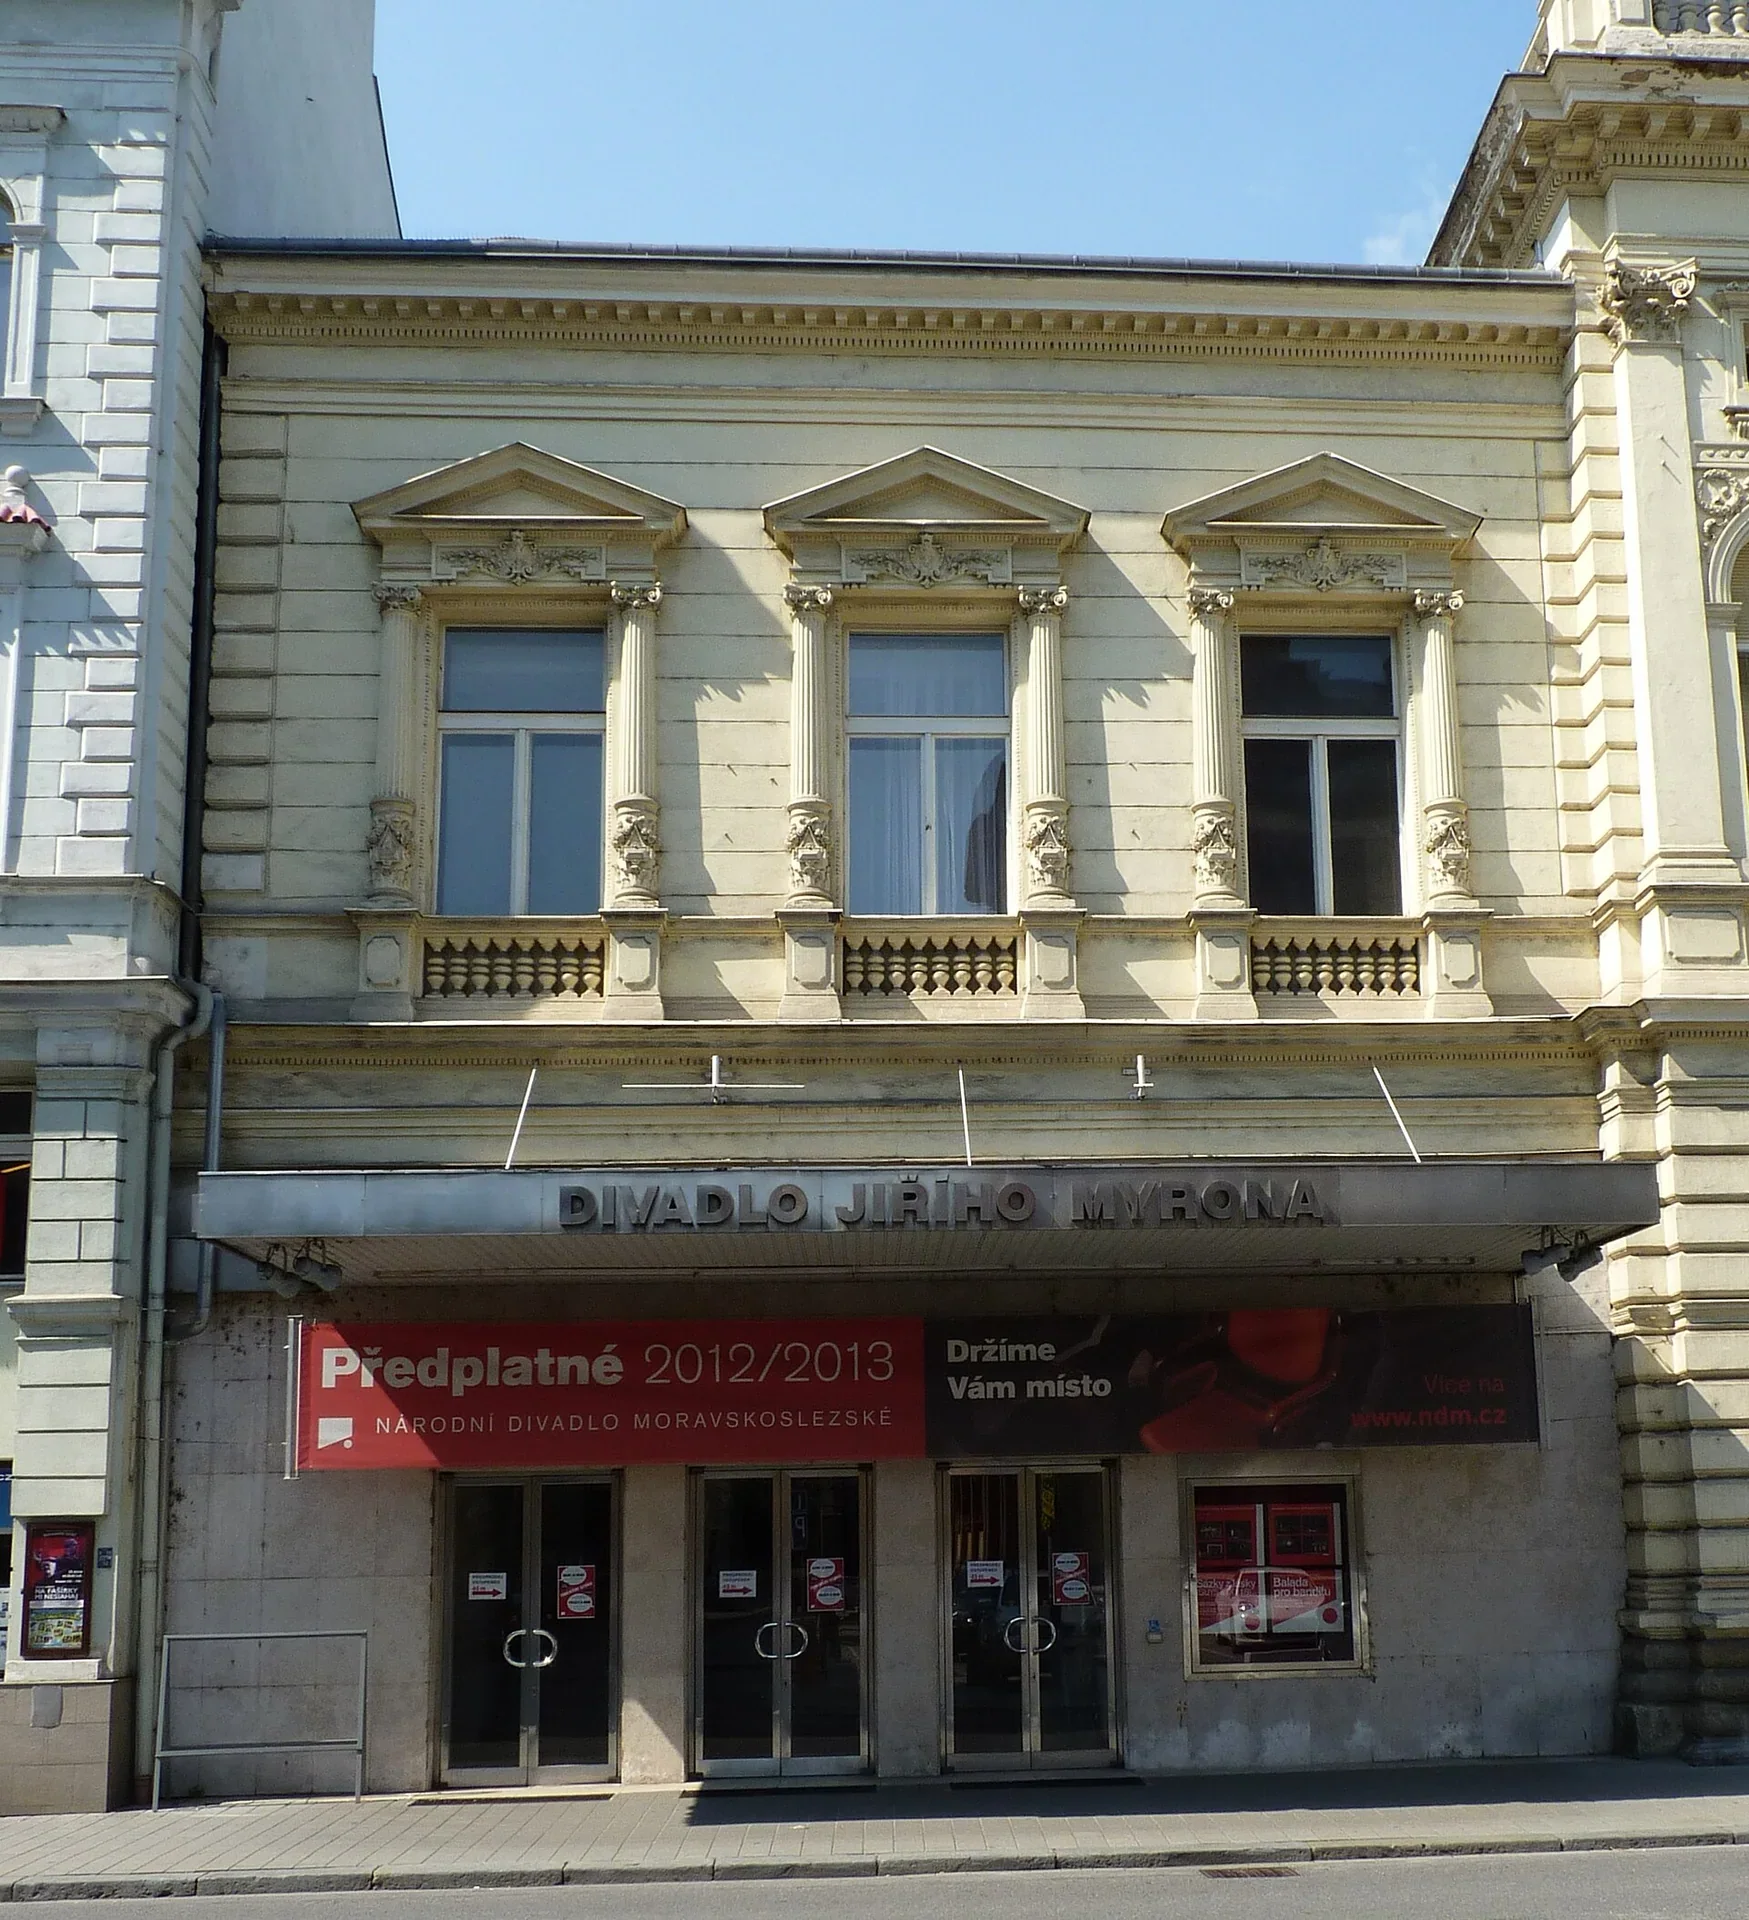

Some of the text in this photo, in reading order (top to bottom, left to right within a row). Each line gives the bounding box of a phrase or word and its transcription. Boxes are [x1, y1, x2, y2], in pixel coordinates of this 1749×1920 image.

[559, 1173, 1323, 1227] DIVADLO JIŘÍHO MYRONA
[946, 1338, 1057, 1363] Držíme
[321, 1341, 895, 1397] Předplatné 2012/2013
[947, 1374, 1113, 1400] Vám místo
[1478, 1374, 1505, 1393] na
[375, 1405, 893, 1434] NÁRODNÍ DIVADLO MORAVSKOSLEZSKÉ
[1351, 1405, 1508, 1428] www.ndm.cz
[1273, 1577, 1309, 1587] Balada
[1273, 1588, 1291, 1598] pro
